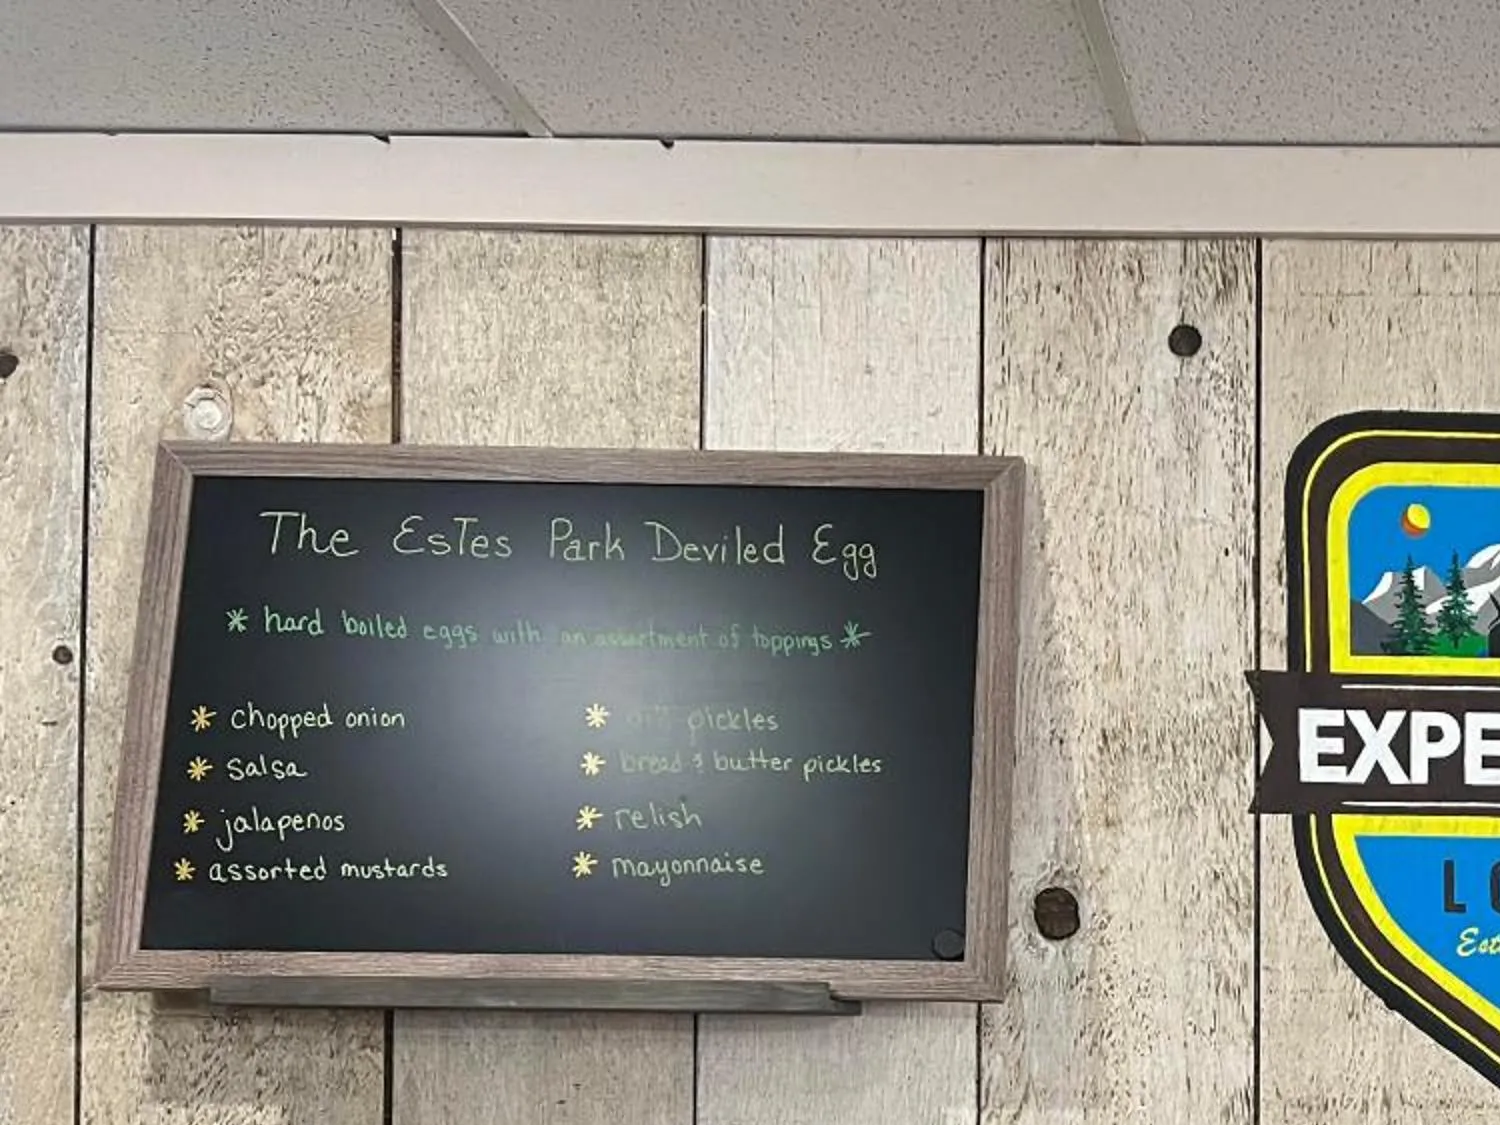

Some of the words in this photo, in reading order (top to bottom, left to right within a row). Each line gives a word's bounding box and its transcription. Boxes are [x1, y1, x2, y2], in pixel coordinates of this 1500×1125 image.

[259, 511, 359, 557] The
[549, 518, 625, 561] Park
[644, 521, 785, 565] Deviled
[812, 523, 877, 581] Egg
[264, 605, 324, 636] hard
[341, 609, 407, 640] boiled
[423, 622, 479, 649] eggs
[492, 620, 542, 645] with
[560, 629, 587, 648] an
[719, 624, 740, 649] of
[752, 624, 833, 656] toppings
[231, 702, 333, 739] chopped
[345, 707, 405, 729] onion
[687, 707, 779, 746] pickles
[620, 750, 682, 775] bread
[713, 748, 793, 773] butter
[803, 754, 882, 782] pickles
[215, 806, 345, 852] jalapenos
[614, 802, 702, 830] relish
[208, 855, 327, 883] assorted
[340, 856, 448, 879] mustards
[611, 852, 765, 887] mayonnaise
